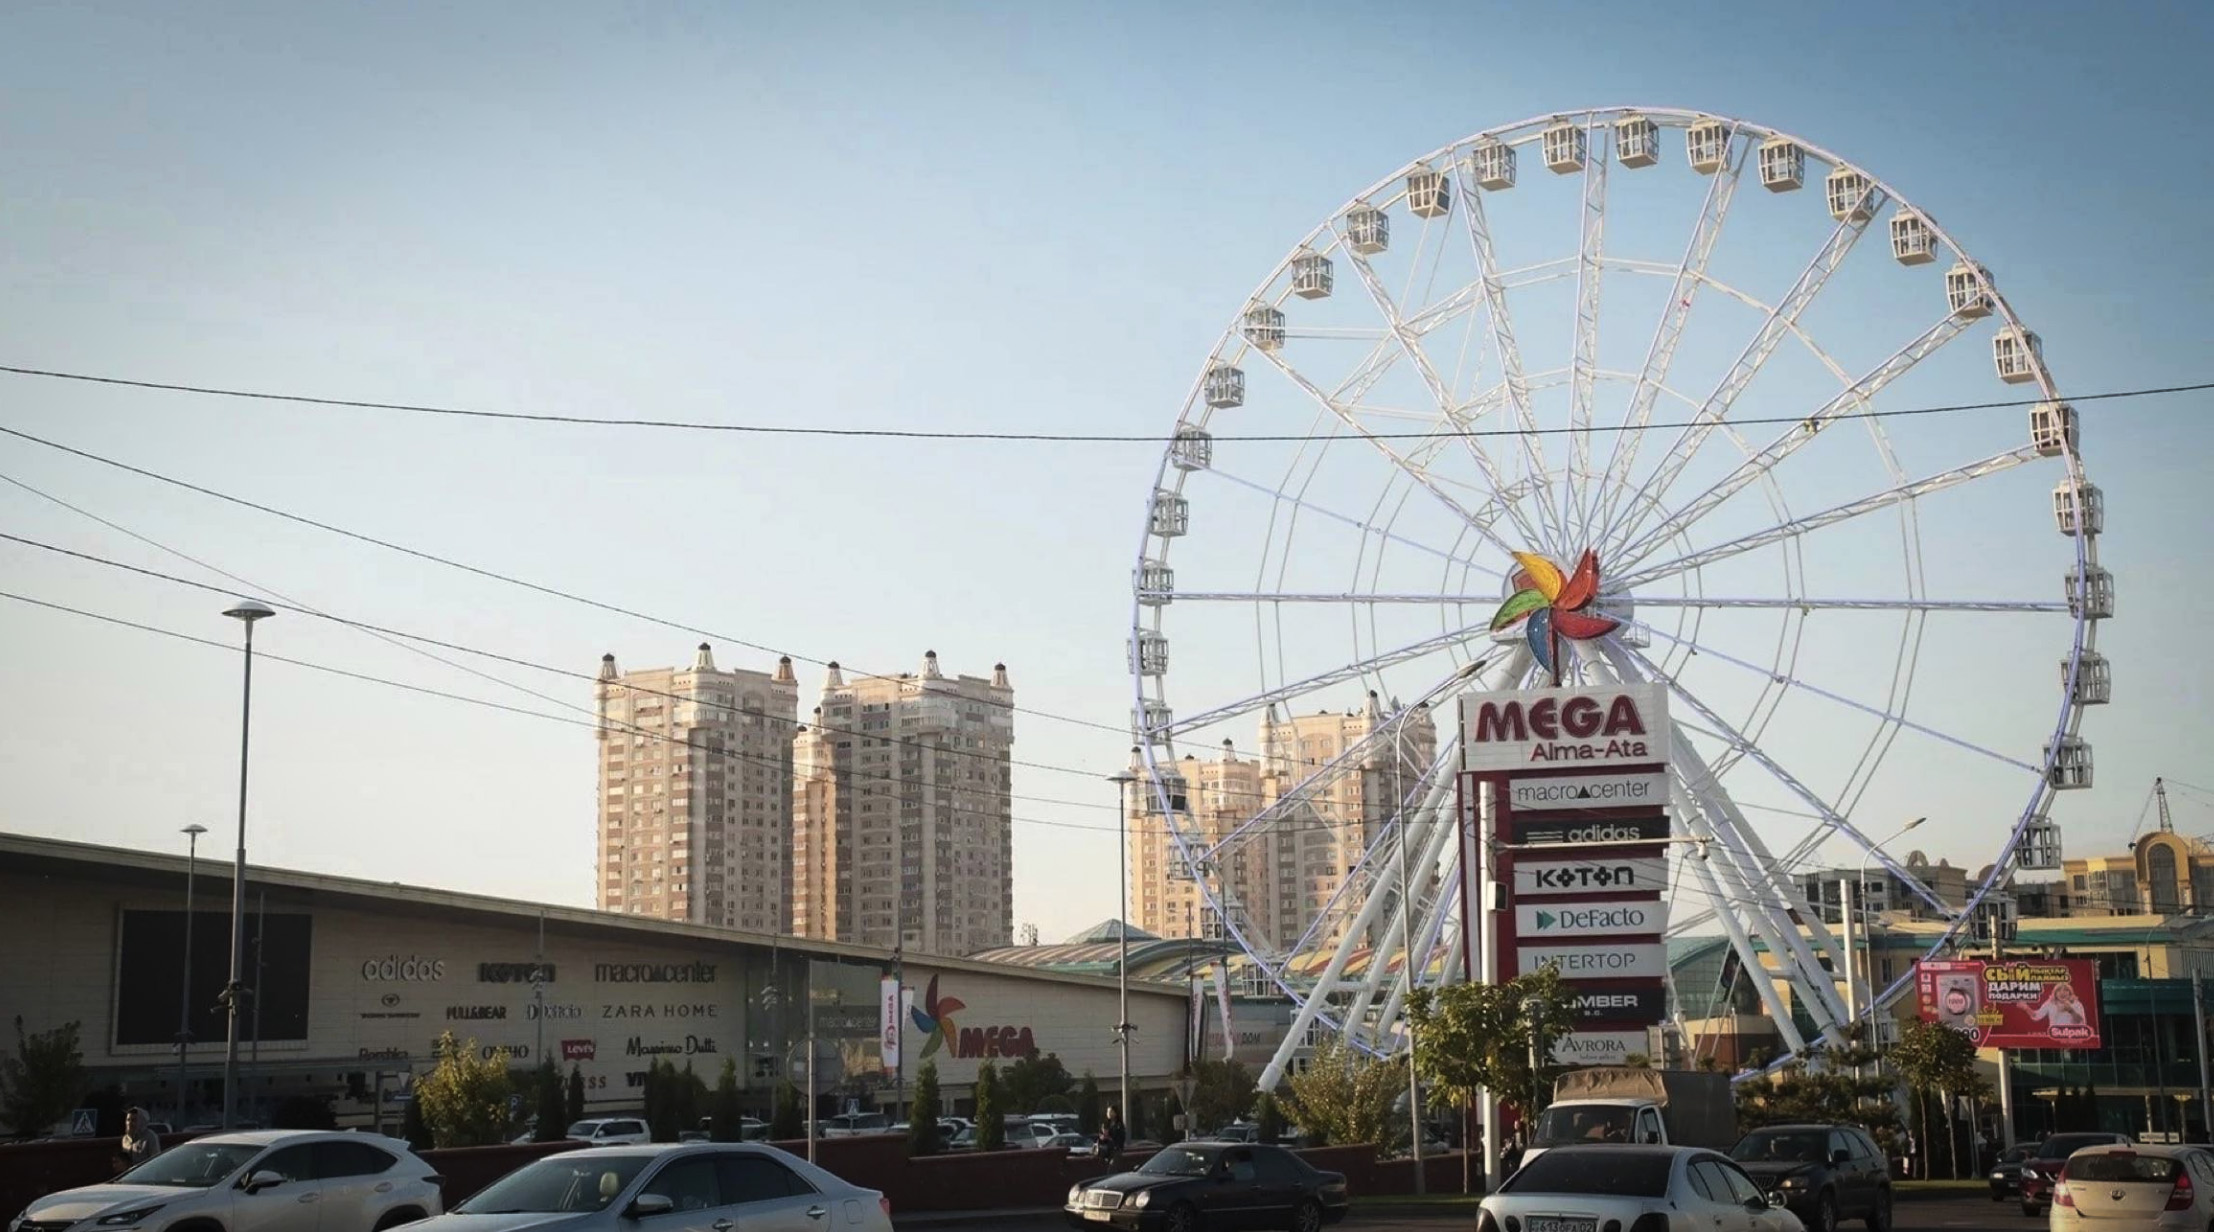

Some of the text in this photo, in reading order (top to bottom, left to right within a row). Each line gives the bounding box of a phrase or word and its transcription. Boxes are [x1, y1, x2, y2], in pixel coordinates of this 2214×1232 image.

[1474, 694, 1647, 742] MEGA
[1530, 739, 1648, 761] Alma-Ata
[1568, 823, 1640, 843] adidas
[1560, 909, 1644, 929] DeFacto
[362, 955, 445, 981] adidas
[1534, 953, 1636, 970] INTERTOP
[1988, 981, 2041, 992] ДАРИМ
[446, 1005, 507, 1020] PULL&BEAR
[602, 1004, 718, 1018] ZARA HOME
[959, 1026, 1037, 1058] MEGA
[2051, 1027, 2089, 1038] Sulpak
